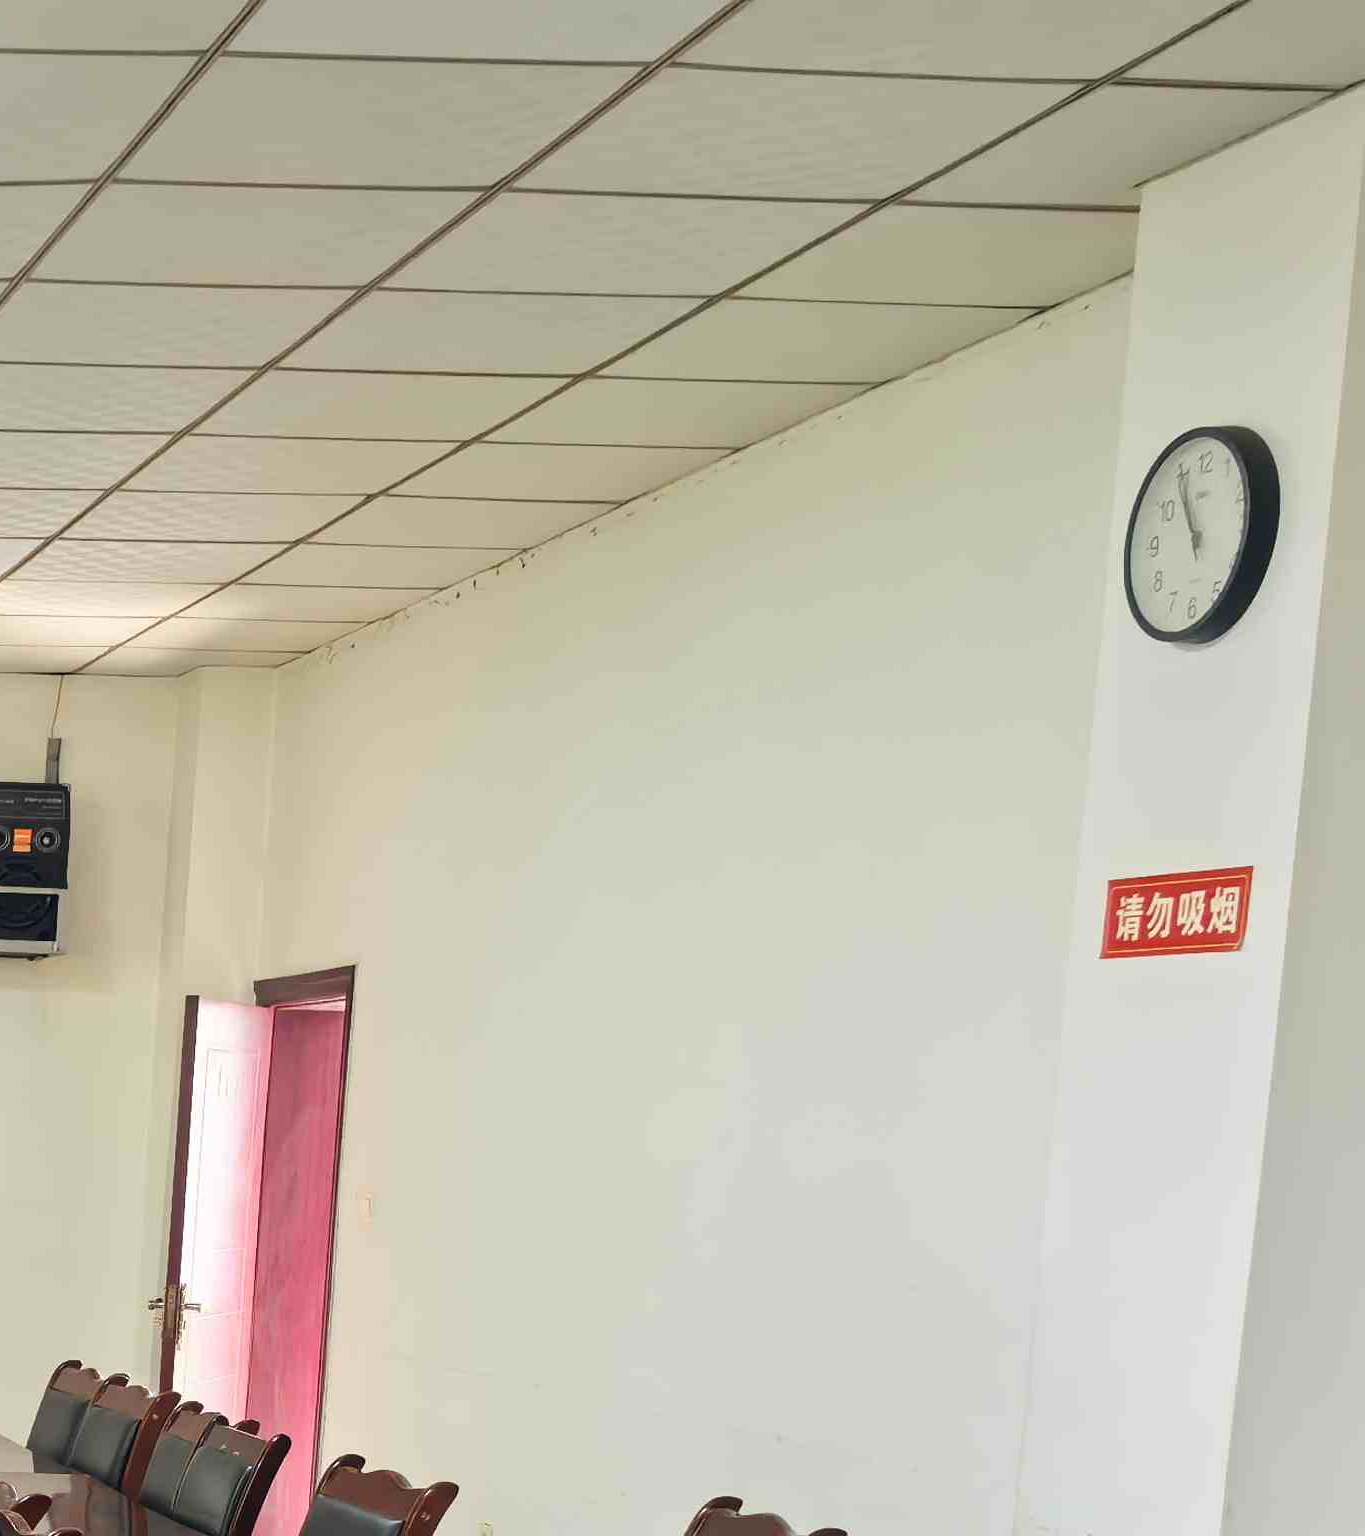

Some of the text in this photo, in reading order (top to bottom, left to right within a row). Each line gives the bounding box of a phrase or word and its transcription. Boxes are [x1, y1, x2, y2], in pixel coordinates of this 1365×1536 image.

[1198, 451, 1214, 474] 12
[1157, 499, 1174, 521] 10
[1149, 536, 1159, 557] 9
[1153, 570, 1163, 592] 8
[1169, 590, 1179, 613] 7
[1116, 886, 1240, 941] 请勿吸烟
